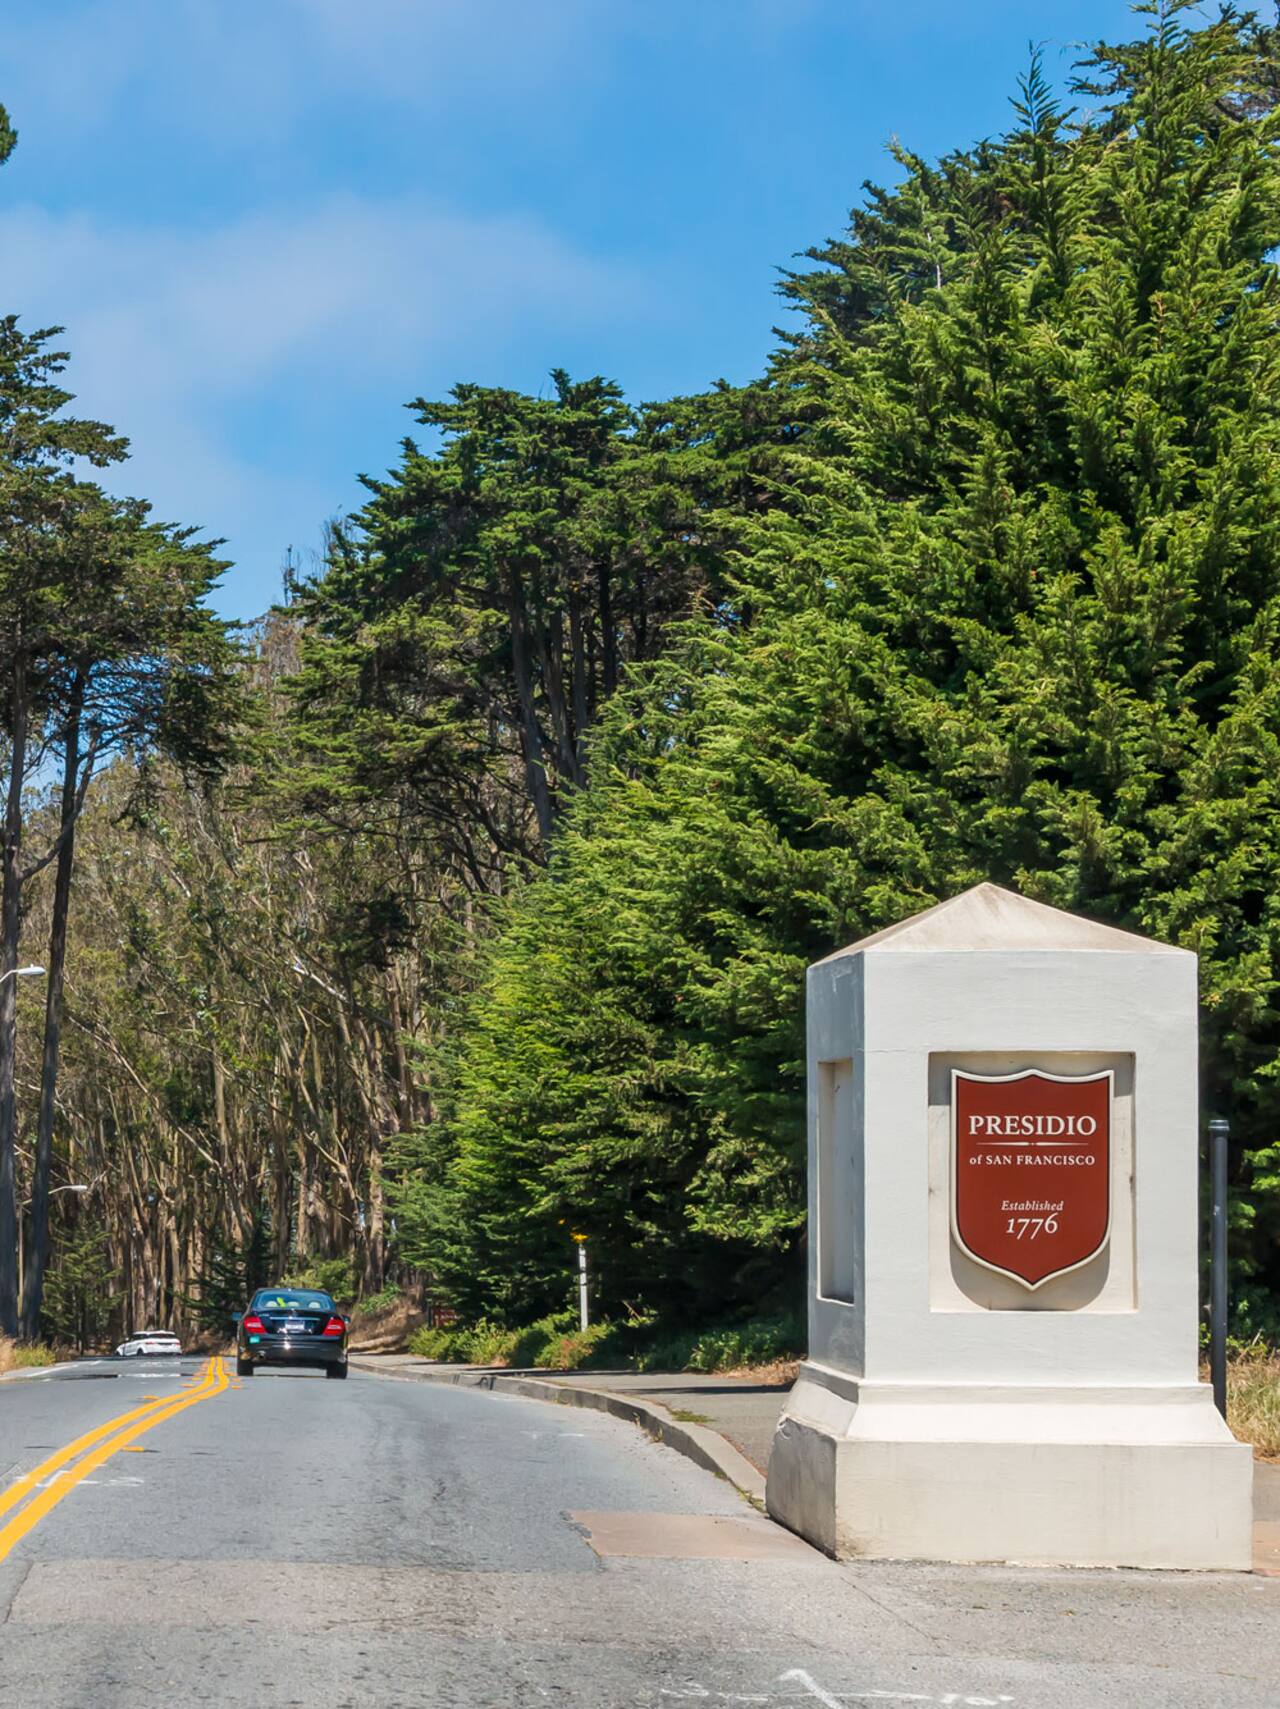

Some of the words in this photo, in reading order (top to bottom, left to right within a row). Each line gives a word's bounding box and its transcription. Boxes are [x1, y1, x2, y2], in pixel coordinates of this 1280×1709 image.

[968, 1115, 1097, 1136] PRESIDIO
[969, 1154, 983, 1166] of
[985, 1154, 1012, 1166] SAN
[1016, 1154, 1096, 1166] FRANCISCO
[1001, 1200, 1065, 1211] Established
[1006, 1212, 1059, 1240] 1776
